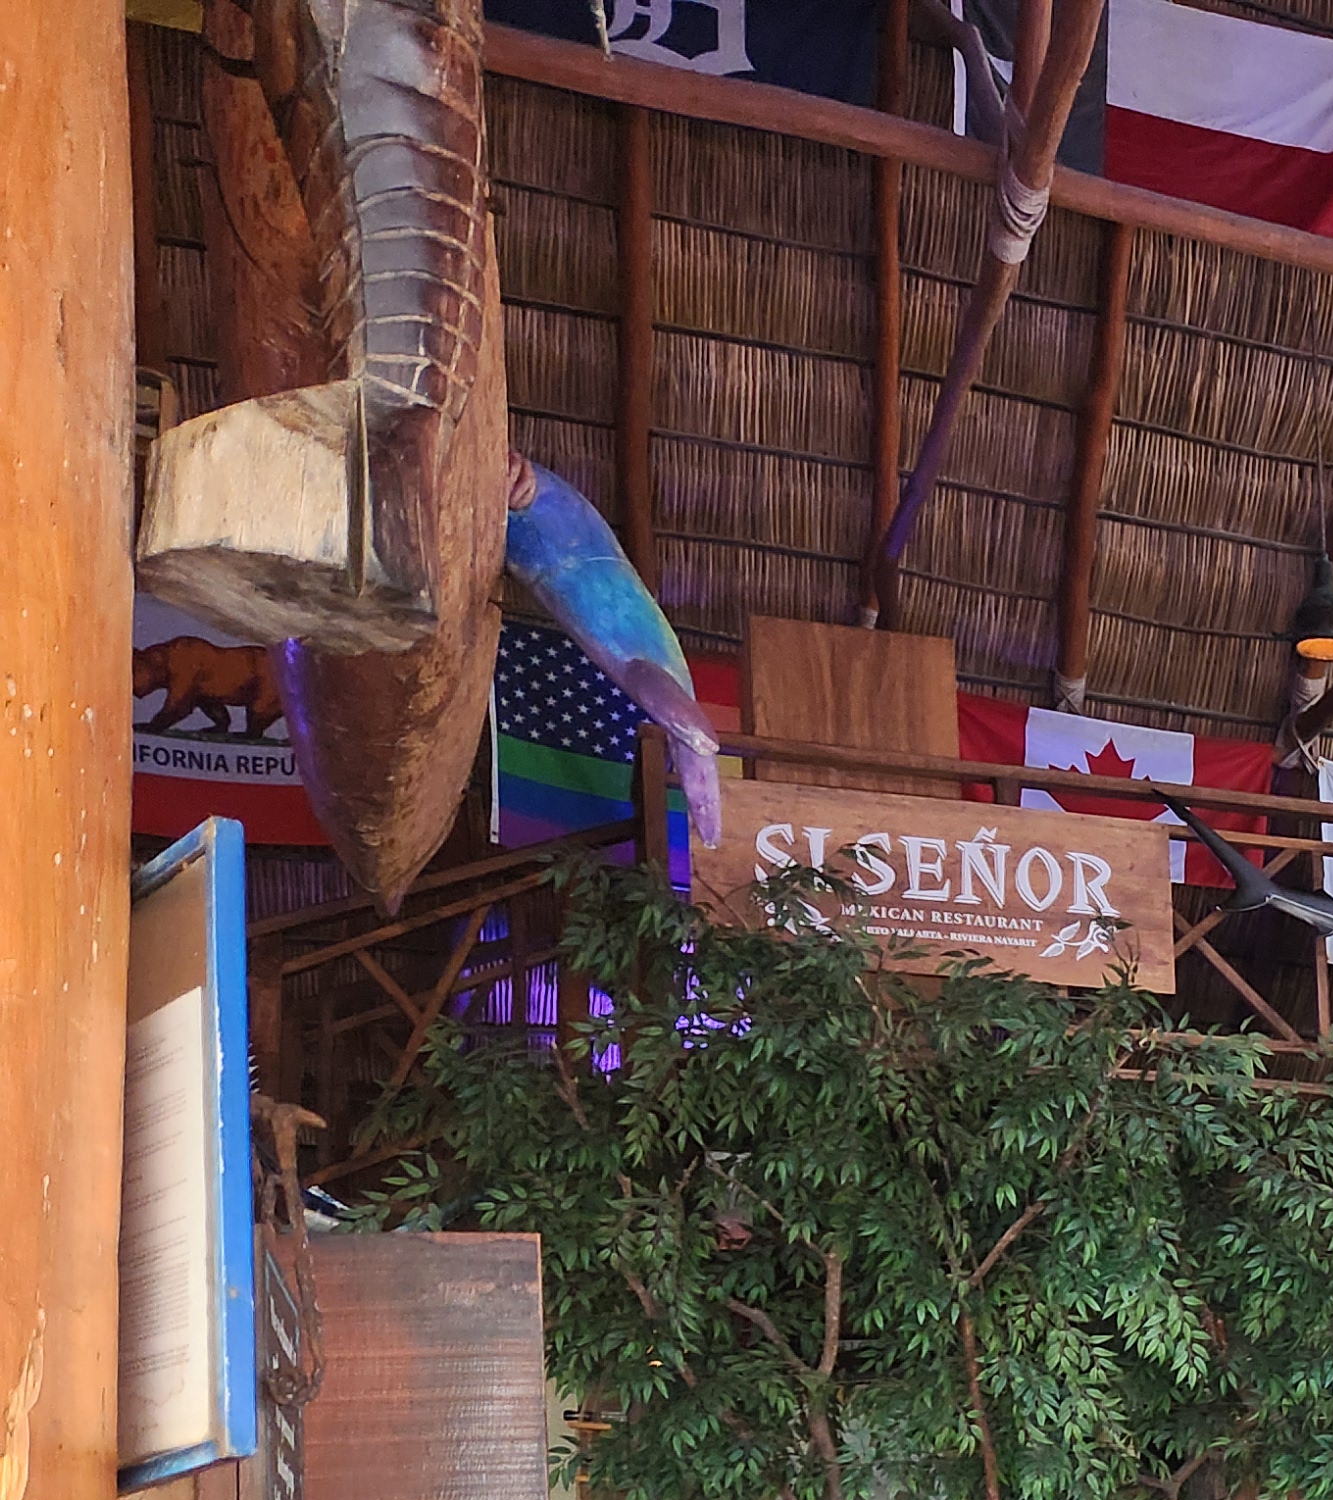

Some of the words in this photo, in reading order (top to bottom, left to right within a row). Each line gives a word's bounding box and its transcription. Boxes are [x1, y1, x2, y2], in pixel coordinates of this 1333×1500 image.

[133, 743, 229, 773] IFORNIA
[236, 753, 296, 776] REPU
[851, 826, 1121, 918] SEÑOR
[841, 903, 925, 923] MXICAN
[931, 910, 1044, 932] RESTAURANT
[950, 933, 993, 944] RIVIERA
[994, 936, 1038, 947] NAYARIT
